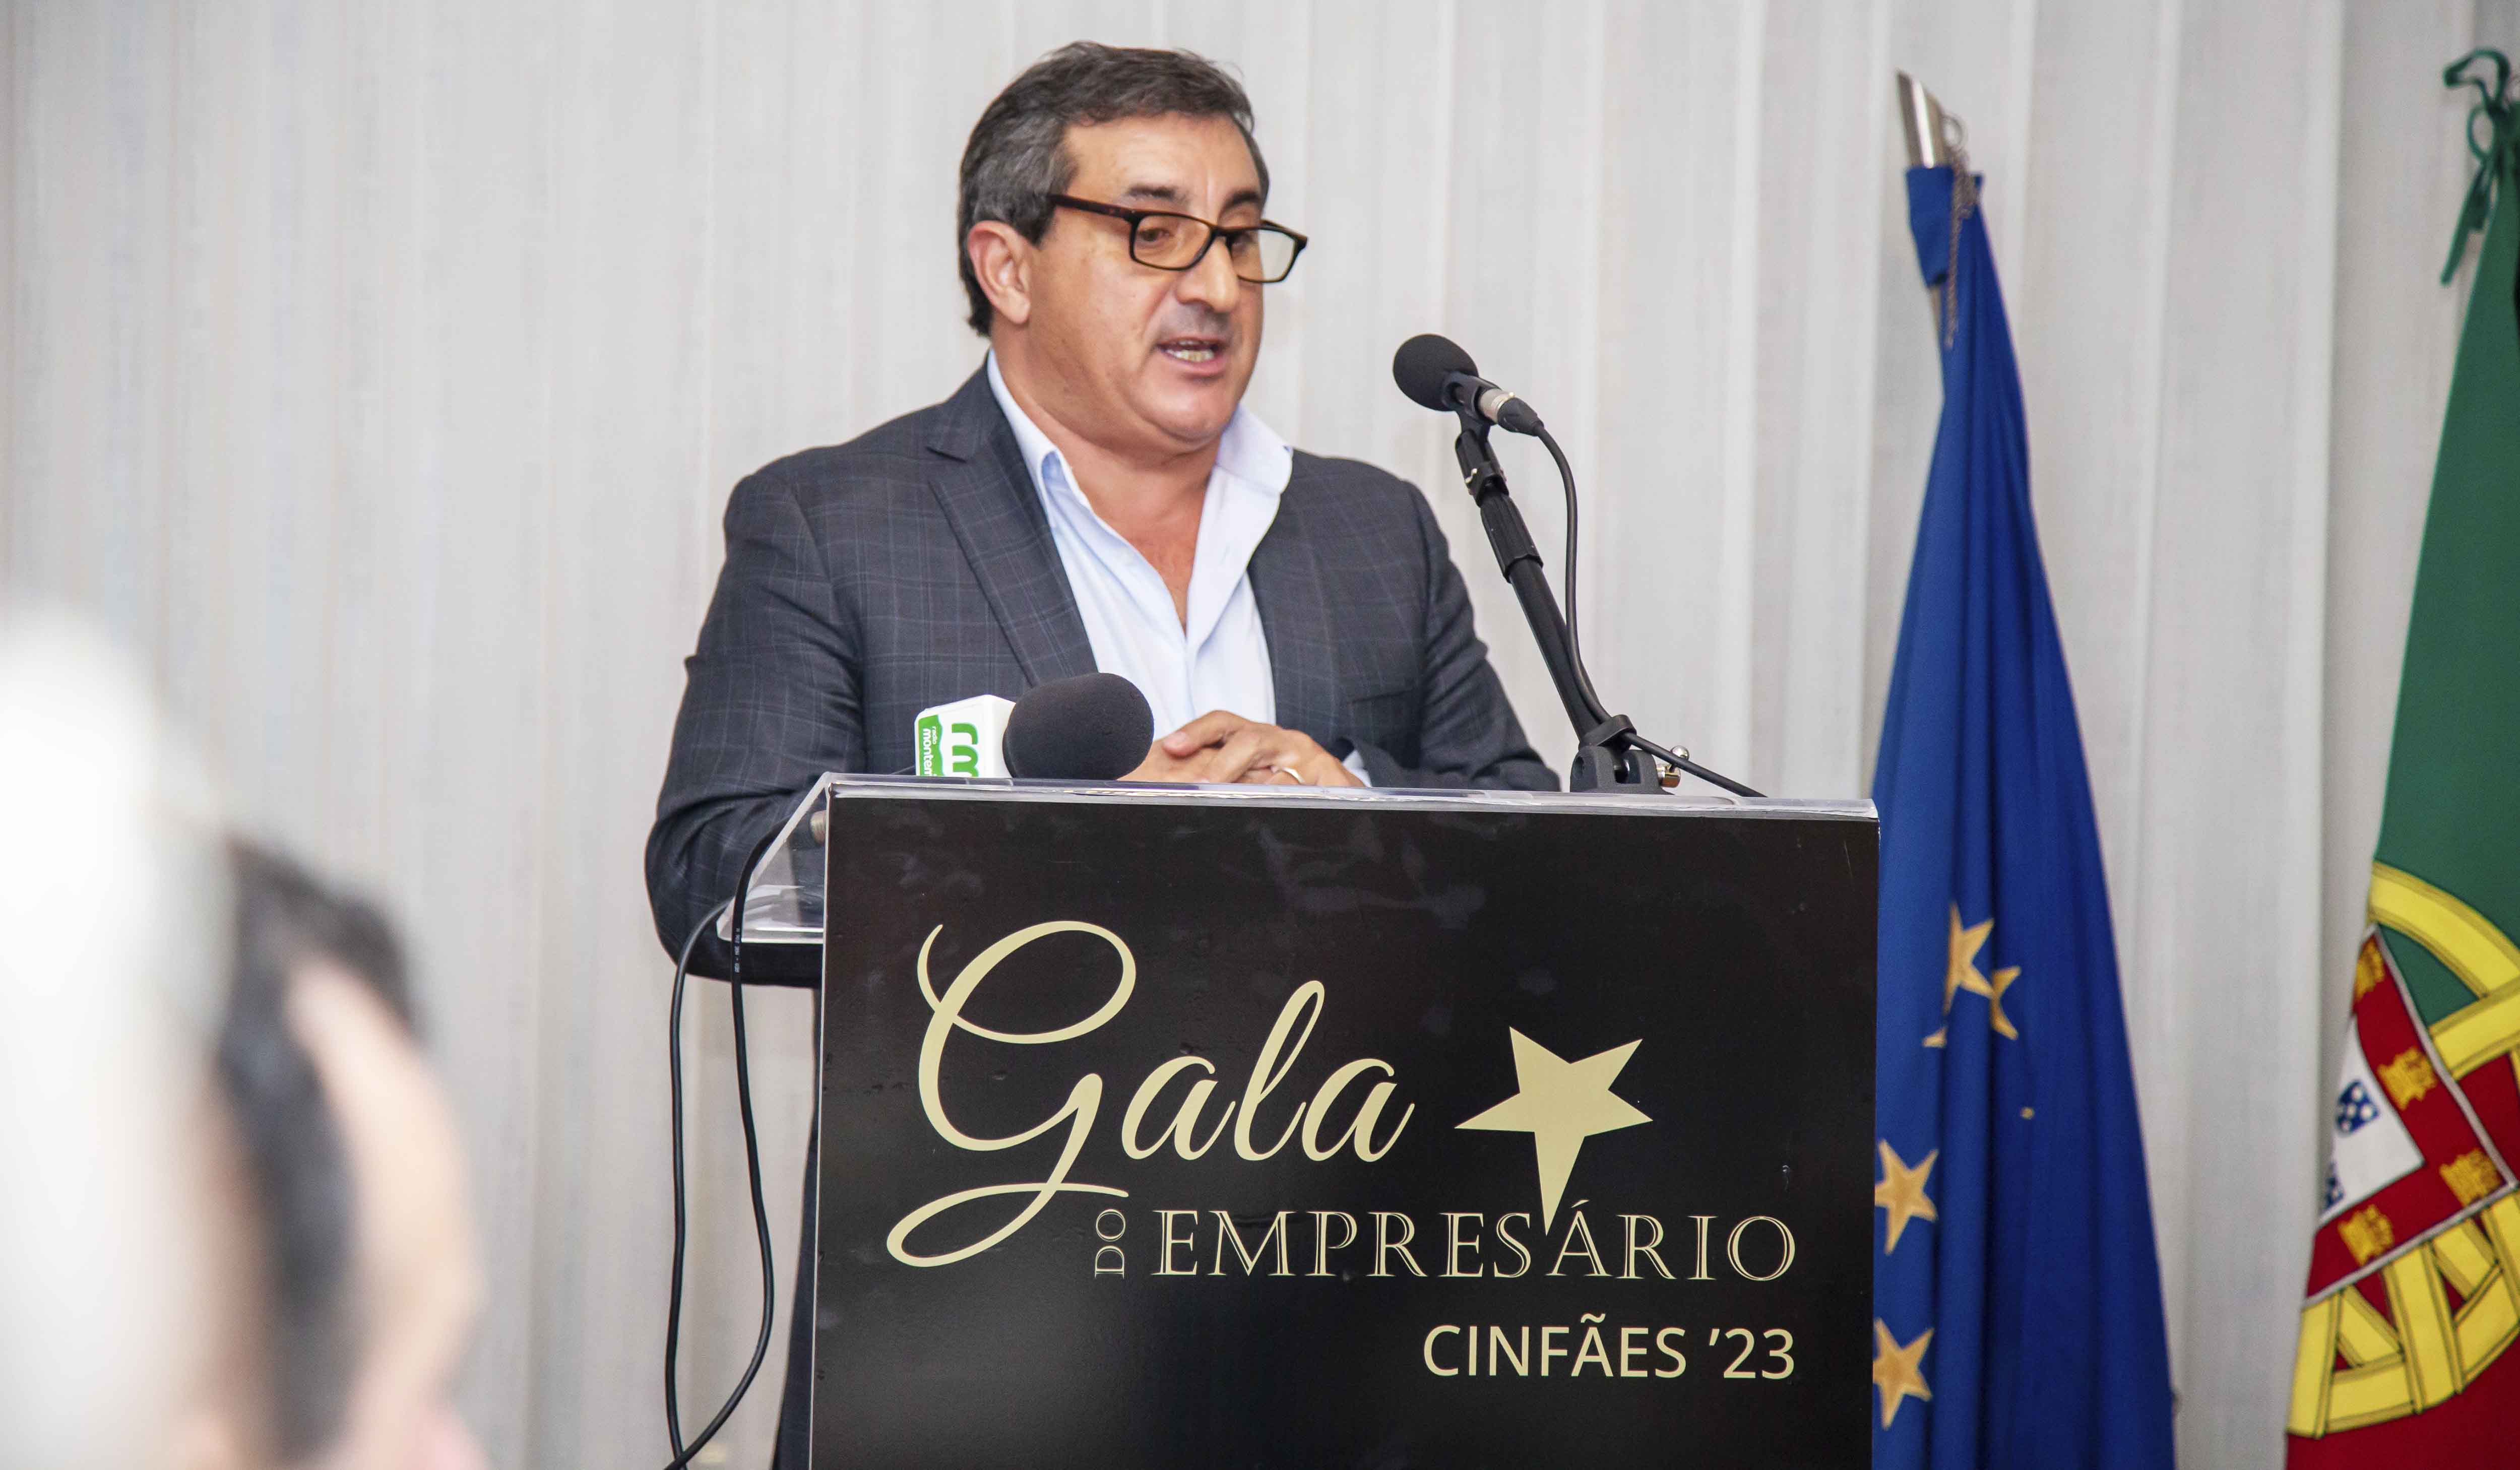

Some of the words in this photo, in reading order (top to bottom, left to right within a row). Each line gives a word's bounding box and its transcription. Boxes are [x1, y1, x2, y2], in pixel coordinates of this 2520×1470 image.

[887, 920, 1416, 1267] Gala
[1094, 1208, 1126, 1279] DO
[1151, 1198, 1796, 1282] EMPRESÁRIO
[1423, 1312, 1687, 1379] CINFÃES
